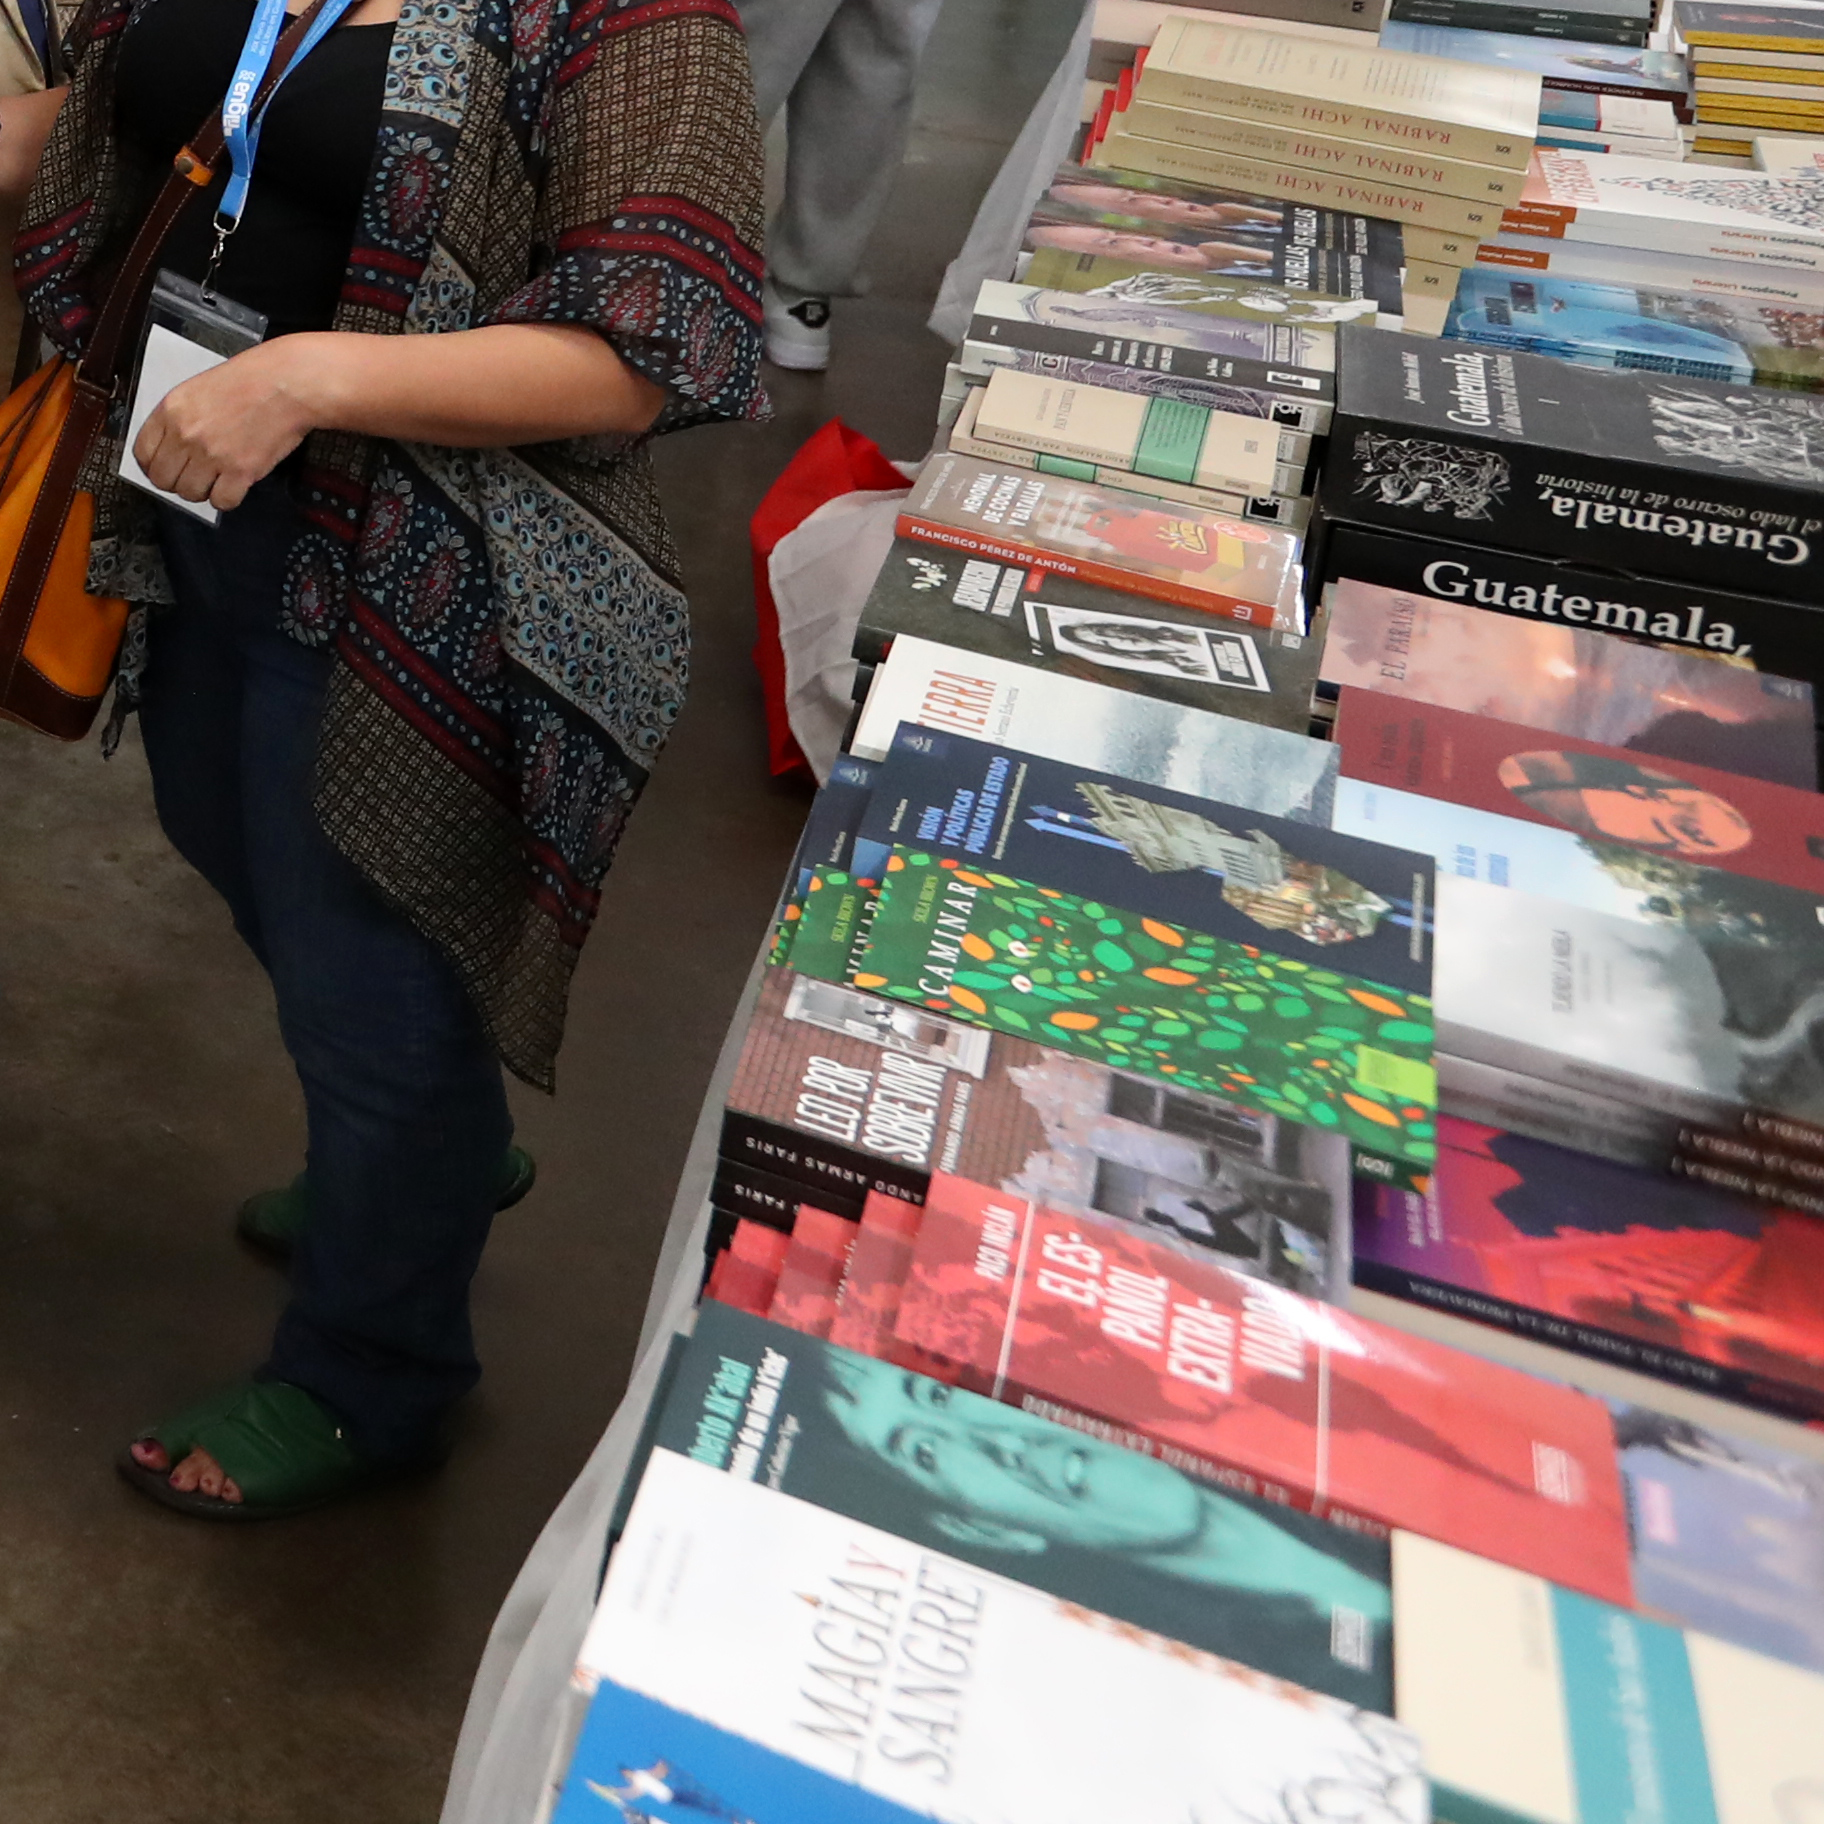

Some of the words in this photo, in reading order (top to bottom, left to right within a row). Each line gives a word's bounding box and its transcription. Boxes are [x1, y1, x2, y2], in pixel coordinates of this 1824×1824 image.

[1301, 107, 1352, 126] ACHI
[1362, 116, 1452, 144] RABINAL
[911, 525, 977, 550] FRANCISCO
[980, 539, 1016, 560] PÉREZ
[1018, 552, 1033, 564] DE
[1034, 554, 1077, 574] ANTÓN
[1537, 488, 1810, 566] Guatemala,
[1386, 597, 1417, 657] PARAÍSO
[1422, 560, 1752, 658] Guatemala,
[1381, 661, 1406, 681] EL
[918, 880, 978, 995] CAMINAR
[802, 1055, 873, 1104] POR
[862, 1051, 947, 1163] SOBREVIVIR
[794, 1093, 862, 1143] LEO
[1100, 1265, 1169, 1352] PAÑOL
[845, 1542, 906, 1580] Y
[877, 1557, 985, 1785] SANGRE
